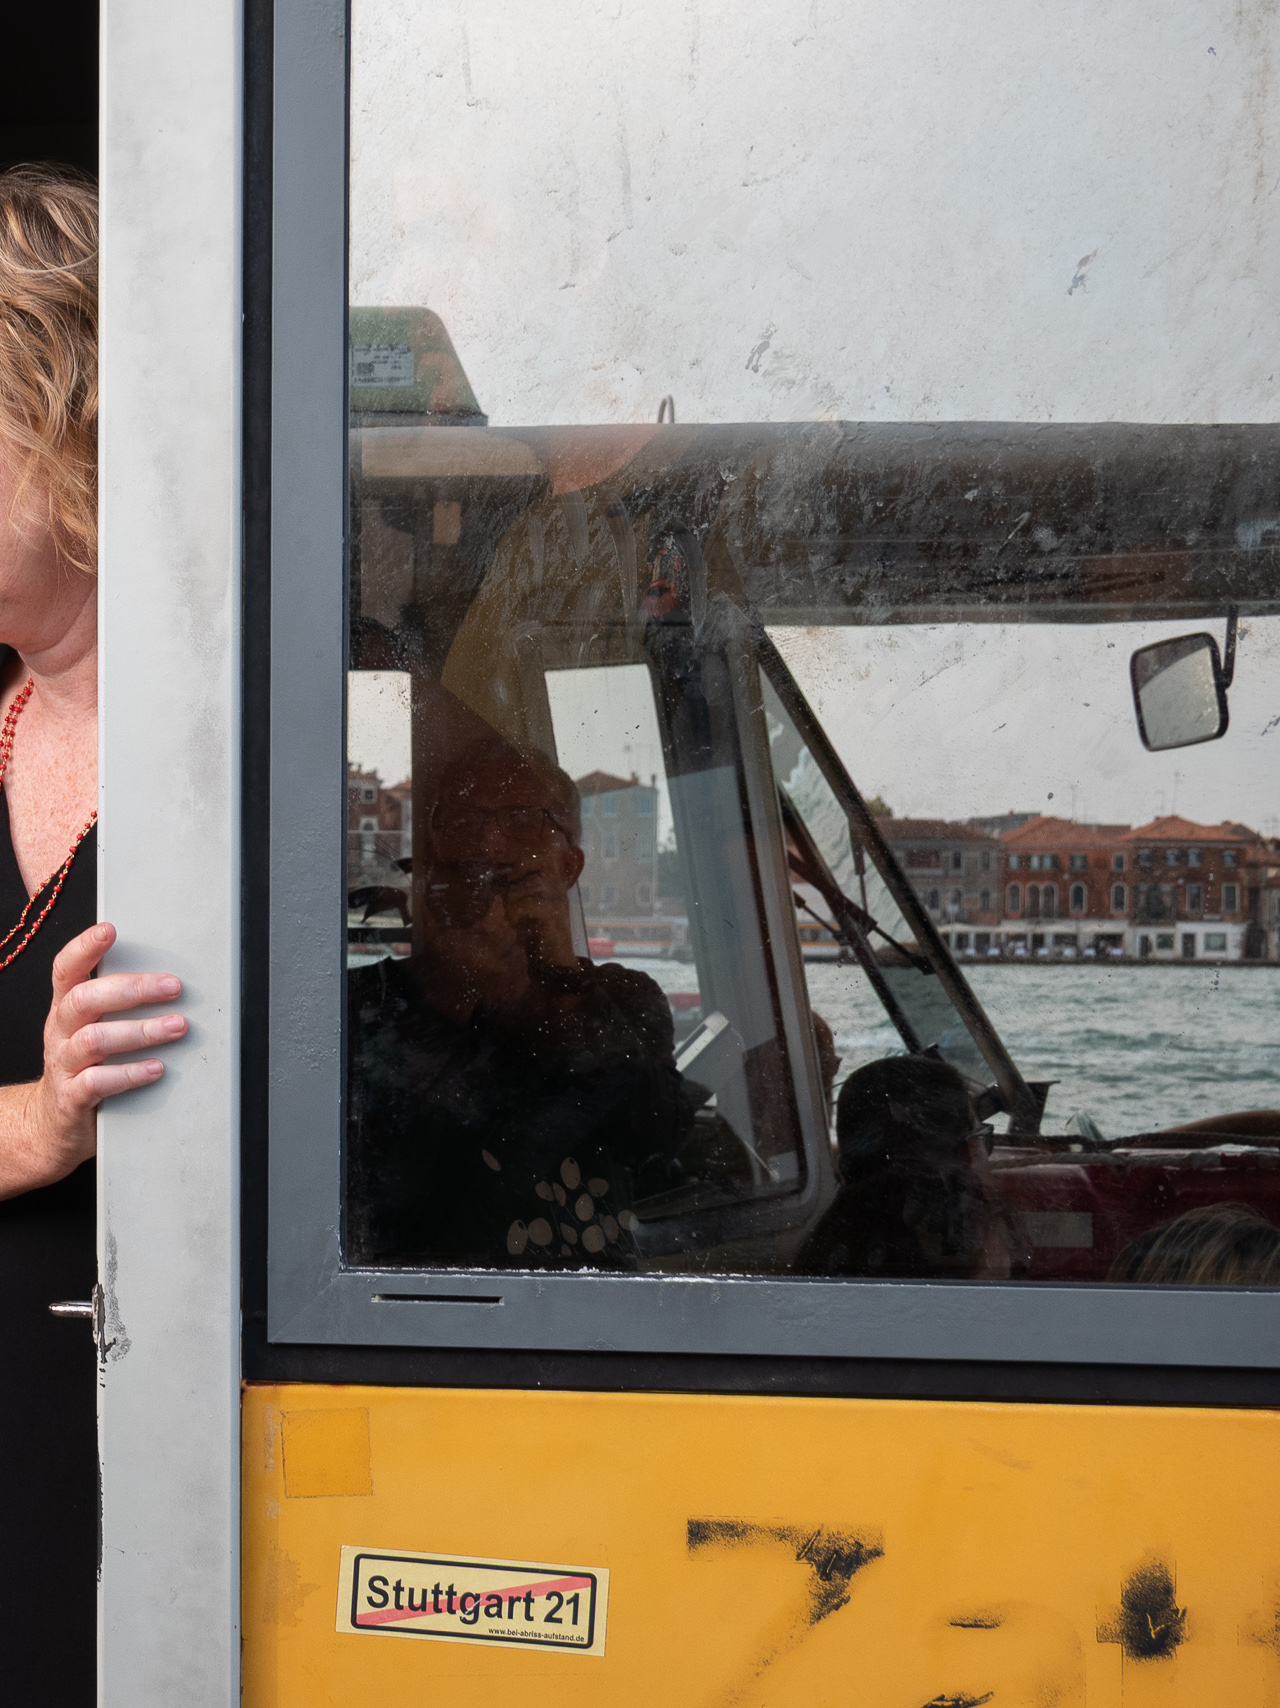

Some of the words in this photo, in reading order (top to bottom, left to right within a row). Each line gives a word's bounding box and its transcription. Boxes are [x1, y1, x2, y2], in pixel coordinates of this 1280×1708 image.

[366, 1575, 535, 1625] Stuttgart
[543, 1590, 581, 1626] 21
[488, 1627, 585, 1643] www.bei-abriss-aufstand.de
